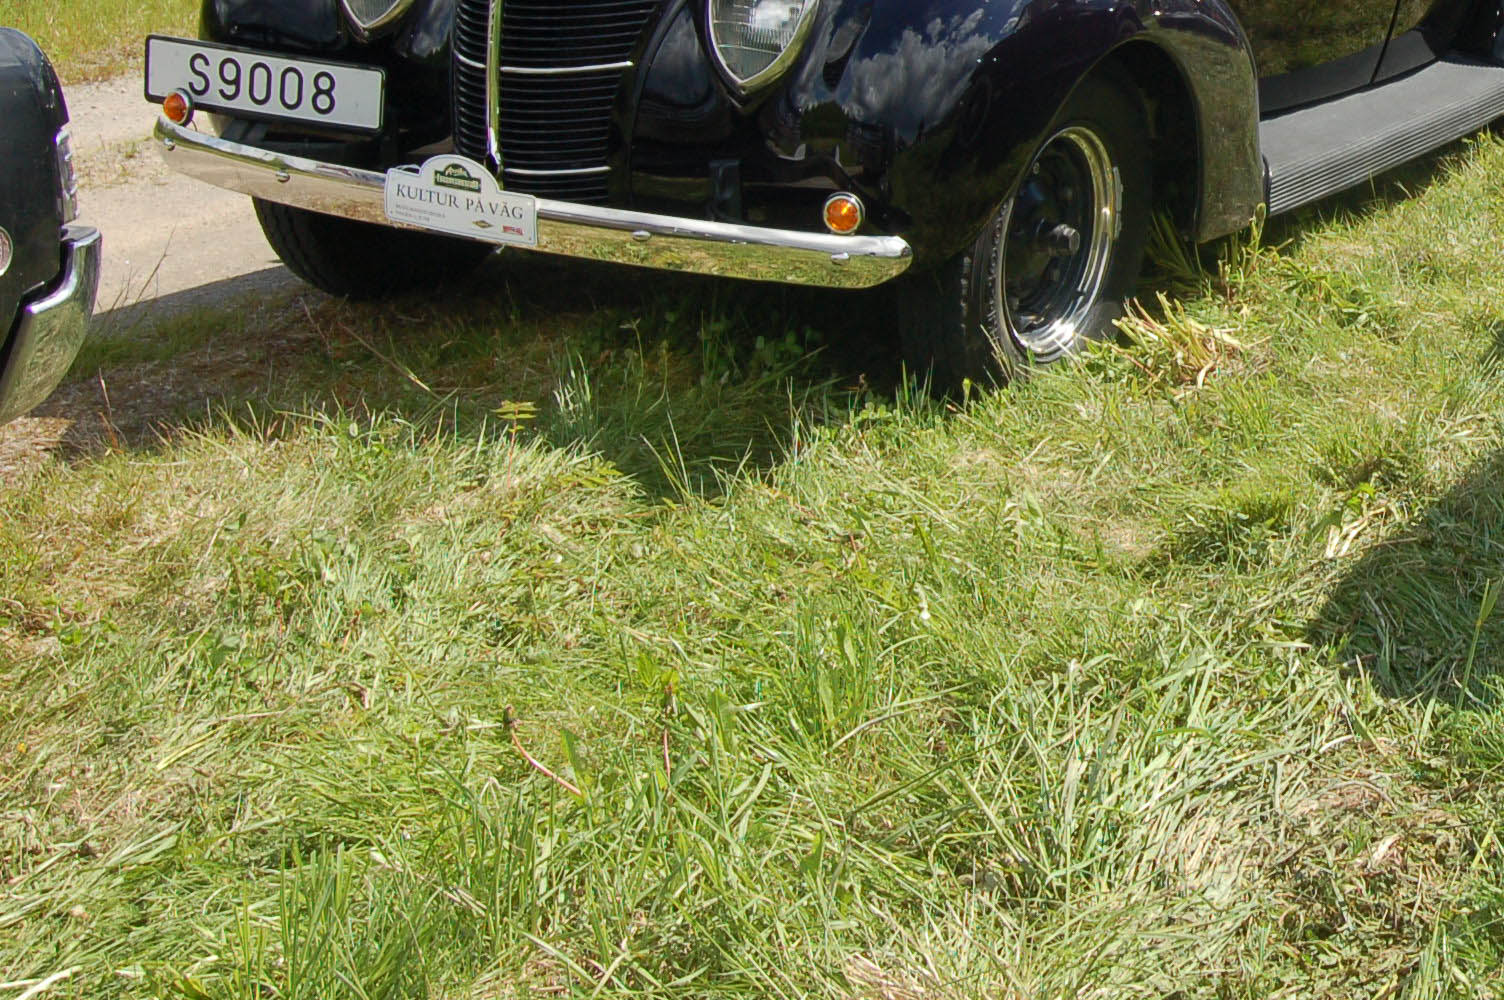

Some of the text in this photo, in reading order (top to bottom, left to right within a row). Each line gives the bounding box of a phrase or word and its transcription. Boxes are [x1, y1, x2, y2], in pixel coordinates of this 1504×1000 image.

[188, 53, 336, 115] S9008
[396, 183, 460, 209] KULTUR
[488, 201, 524, 220] VÄG
